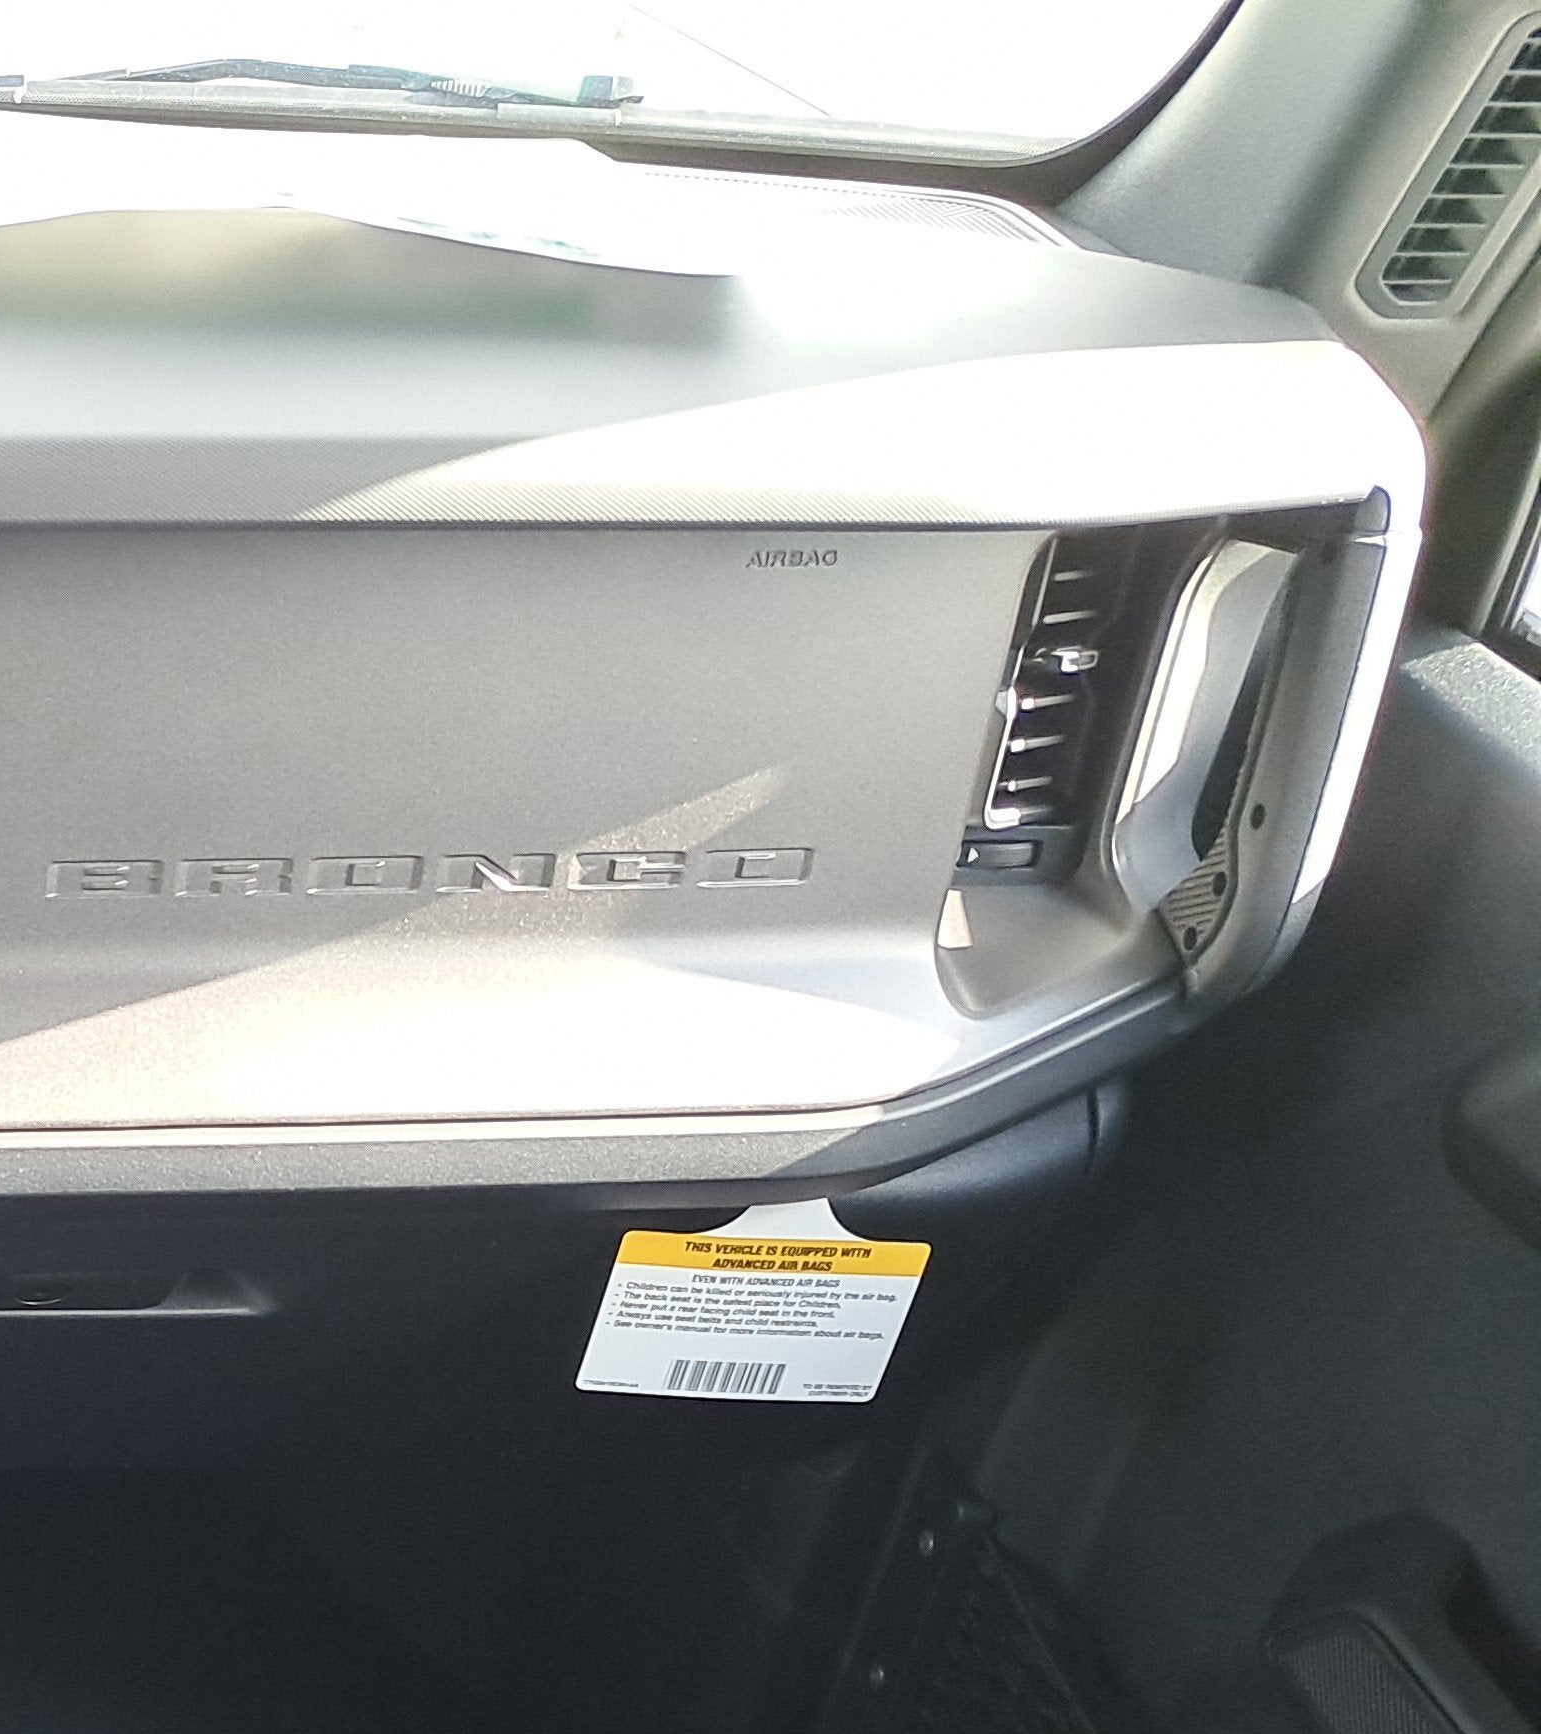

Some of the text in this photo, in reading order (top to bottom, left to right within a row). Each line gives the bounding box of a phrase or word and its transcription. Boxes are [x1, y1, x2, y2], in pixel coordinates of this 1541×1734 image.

[746, 550, 838, 567] AIRBAG
[45, 847, 815, 899] BRONCO
[685, 1241, 872, 1258] THIS VEHICLE IS EQUIPPED WITH
[712, 1258, 833, 1271] ADVANCED AIR BAGS
[627, 1281, 668, 1291] Children
[719, 1276, 745, 1284] WITH
